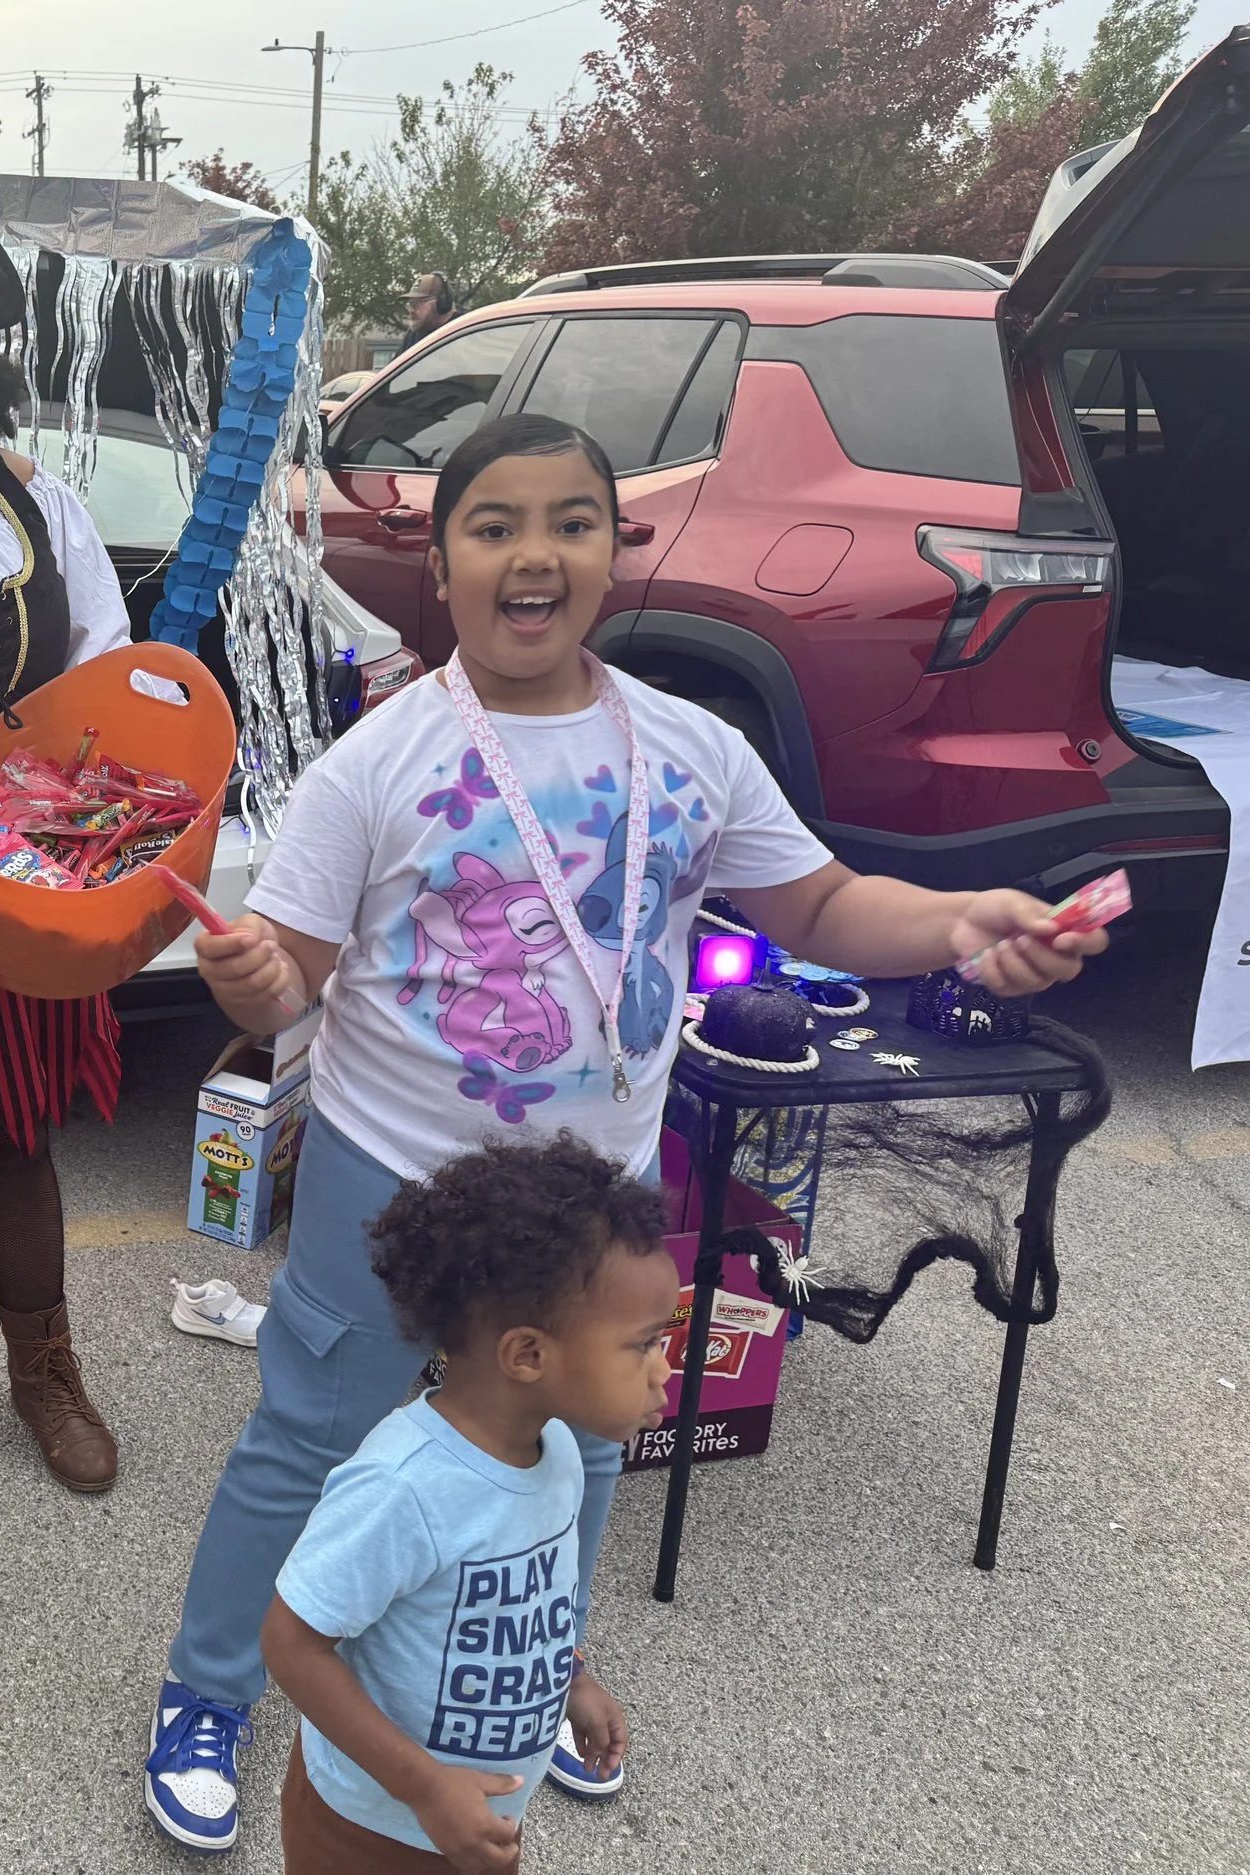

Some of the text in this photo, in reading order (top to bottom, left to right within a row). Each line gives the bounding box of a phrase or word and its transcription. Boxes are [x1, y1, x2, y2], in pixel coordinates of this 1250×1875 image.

[206, 1102, 233, 1116] VEGGIE
[230, 1103, 250, 1114] FRUIT
[239, 1125, 251, 1133] 90
[717, 1304, 769, 1319] WHOPPERS
[464, 1546, 558, 1608] PLAY
[449, 1645, 574, 1706] CRAS
[438, 1701, 560, 1753] REPE
